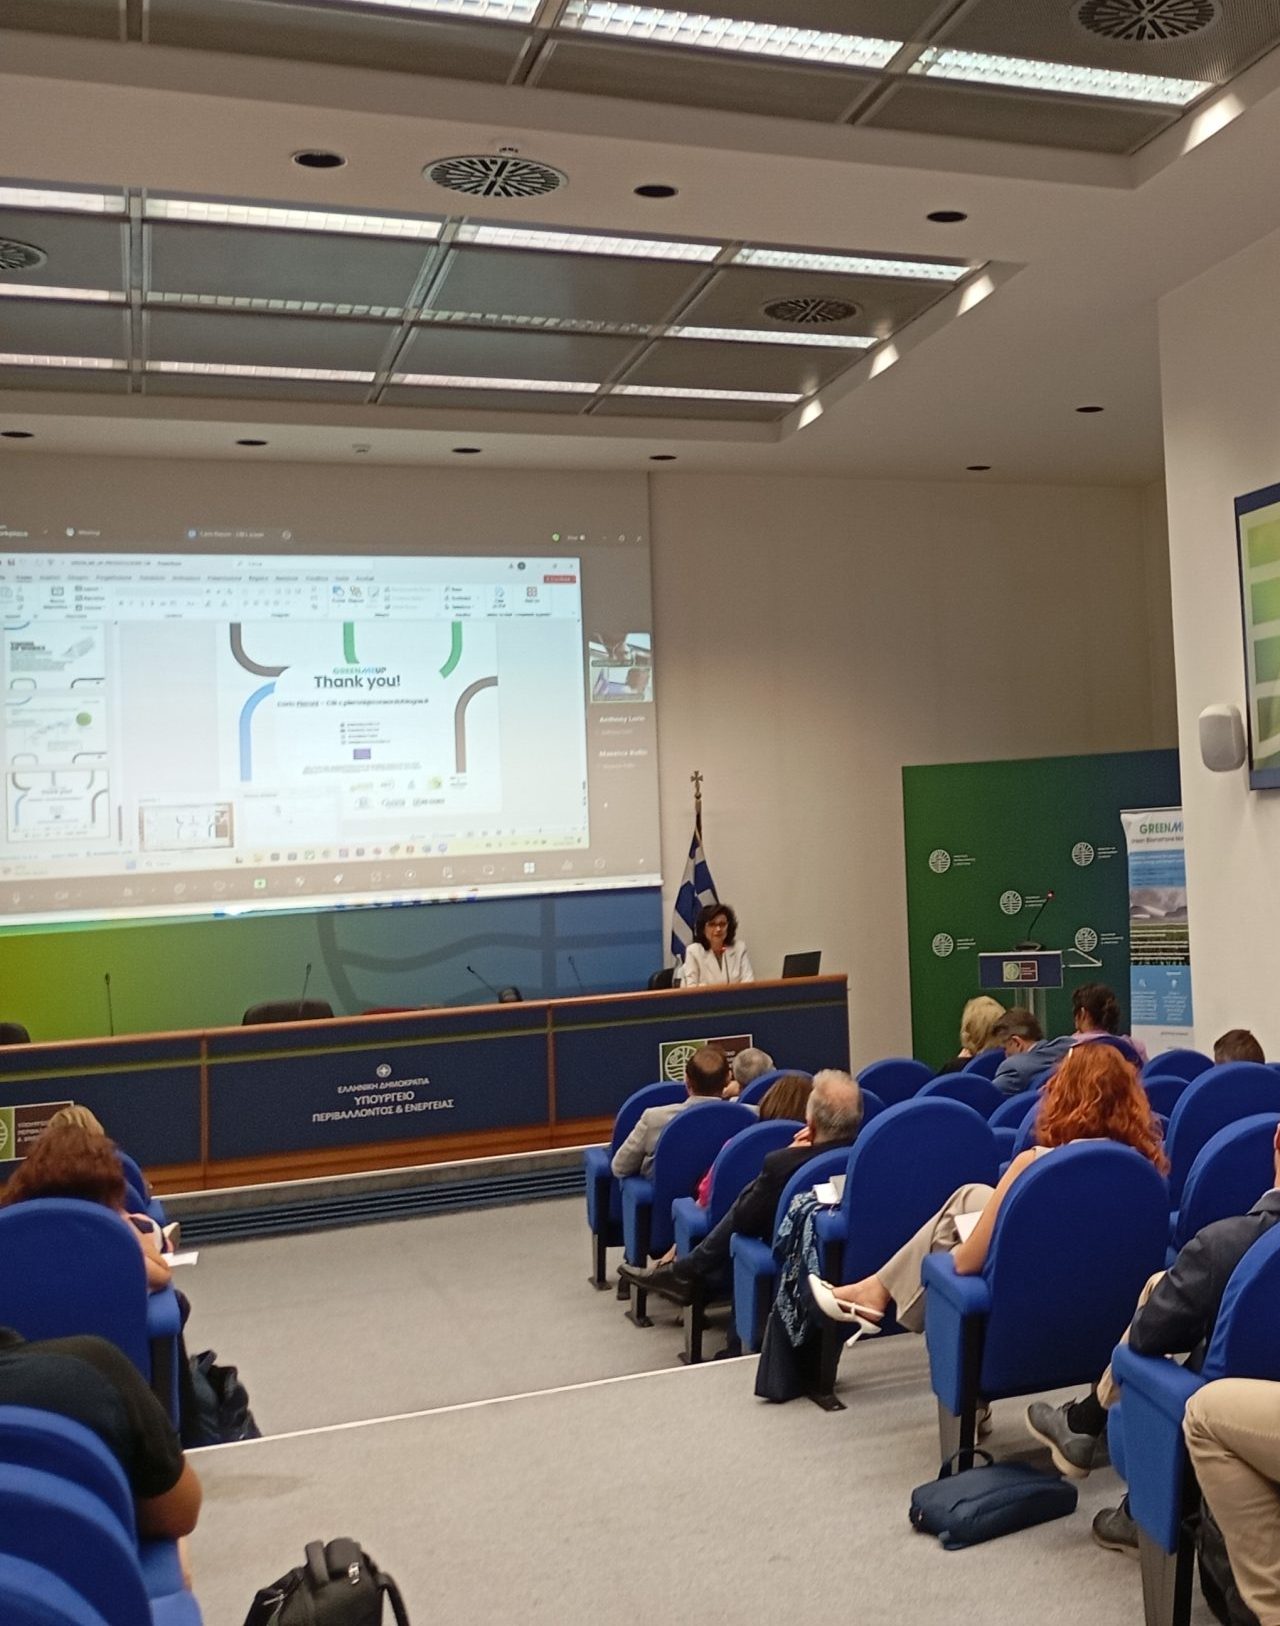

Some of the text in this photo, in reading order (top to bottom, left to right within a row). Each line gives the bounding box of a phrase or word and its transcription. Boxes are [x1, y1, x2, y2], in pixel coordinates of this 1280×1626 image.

[314, 675, 401, 690] Thank you!
[337, 1077, 430, 1094] ΕΛΛΗΝΙΚΗ ΔΗΜΟΚΡΑΤΙΑ
[354, 1090, 415, 1106] ΥΠΟΥΡΓΕΙΟ
[312, 1099, 455, 1123] ΠΕΡΙΒΑΛΛΟΝΤΟΣ & ΕΝΕΡΓΕΙΑΣ
